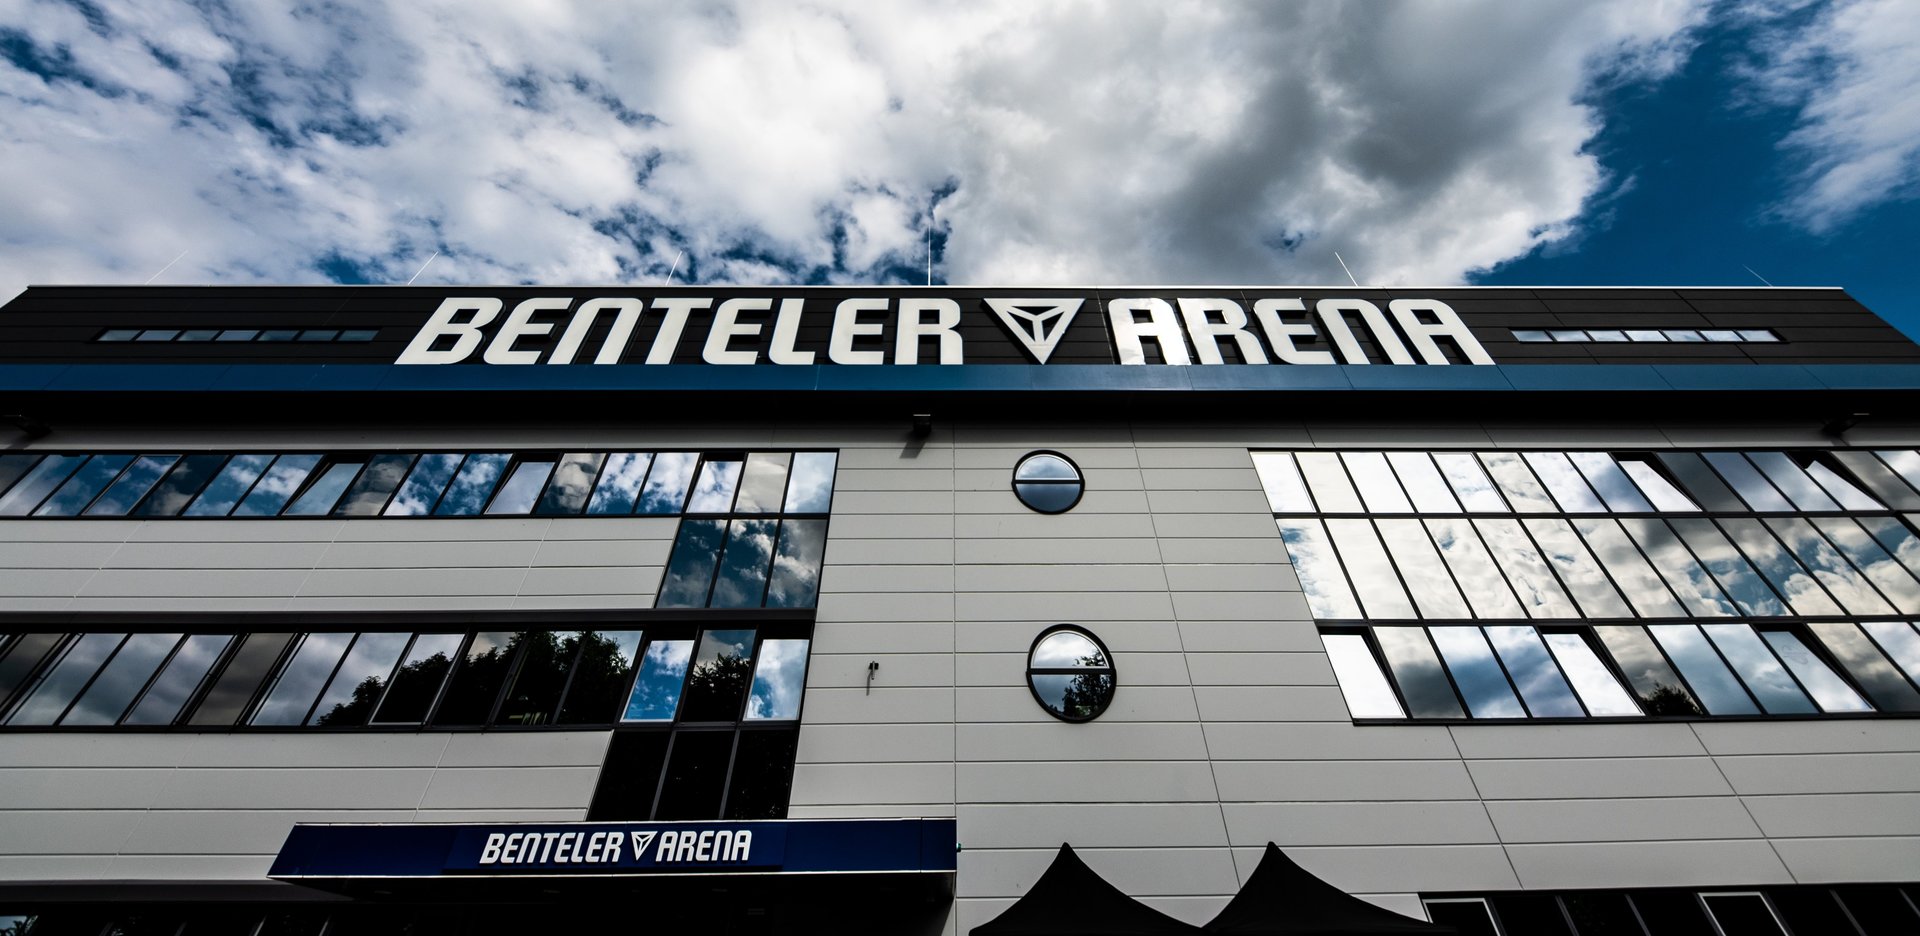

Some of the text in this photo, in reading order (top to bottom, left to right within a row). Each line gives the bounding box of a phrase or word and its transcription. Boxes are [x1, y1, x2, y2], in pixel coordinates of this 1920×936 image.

[394, 297, 1495, 366] BENTELER ARENA
[479, 829, 753, 864] BENTELER ARENA
